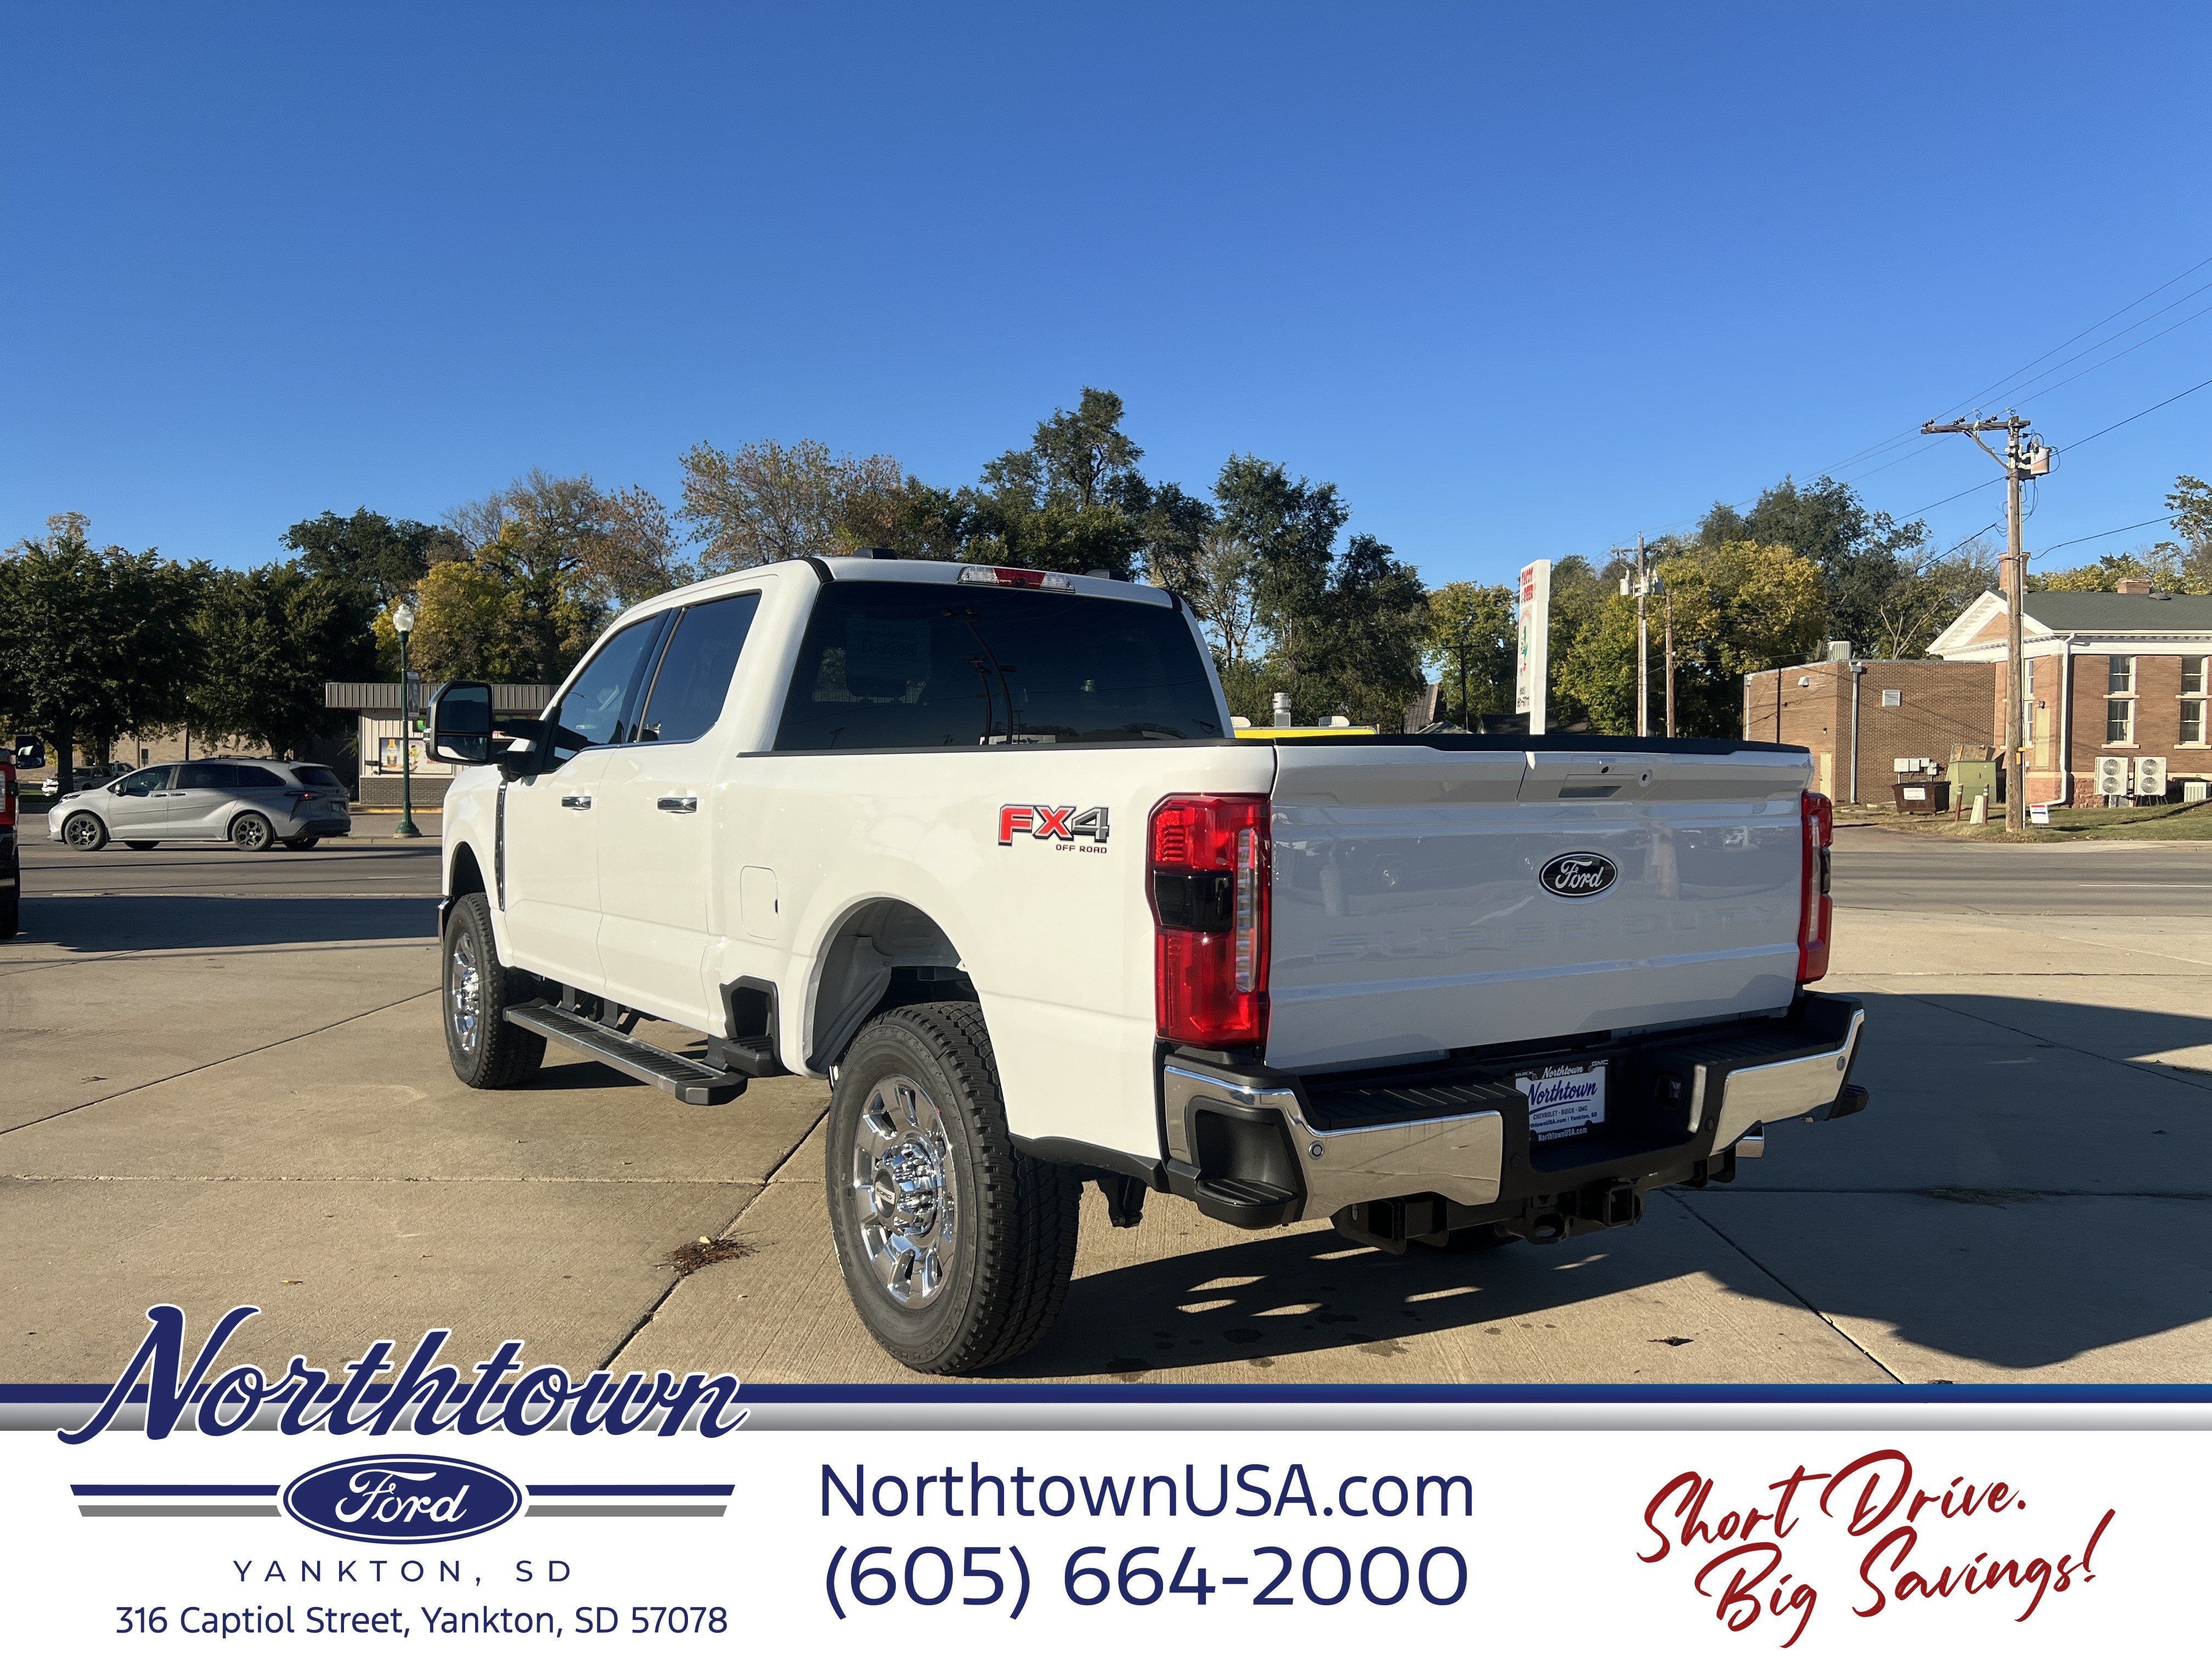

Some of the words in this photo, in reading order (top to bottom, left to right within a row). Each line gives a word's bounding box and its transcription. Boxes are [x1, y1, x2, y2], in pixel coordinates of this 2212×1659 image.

[998, 804, 1110, 847] FX4
[1079, 845, 1107, 854] ROAD
[1555, 860, 1605, 889] Ford
[1314, 919, 1600, 962] SUPER
[1622, 905, 1783, 939] DUTY
[1542, 1065, 1583, 1079] Northtown
[1528, 1080, 1598, 1105] Northtown
[1533, 1110, 1558, 1120] CHEVROLET
[1530, 1118, 1566, 1127] thtownUSA.com
[1538, 1127, 1587, 1142] NorthtownUSA.com
[877, 1187, 892, 1200] FORD
